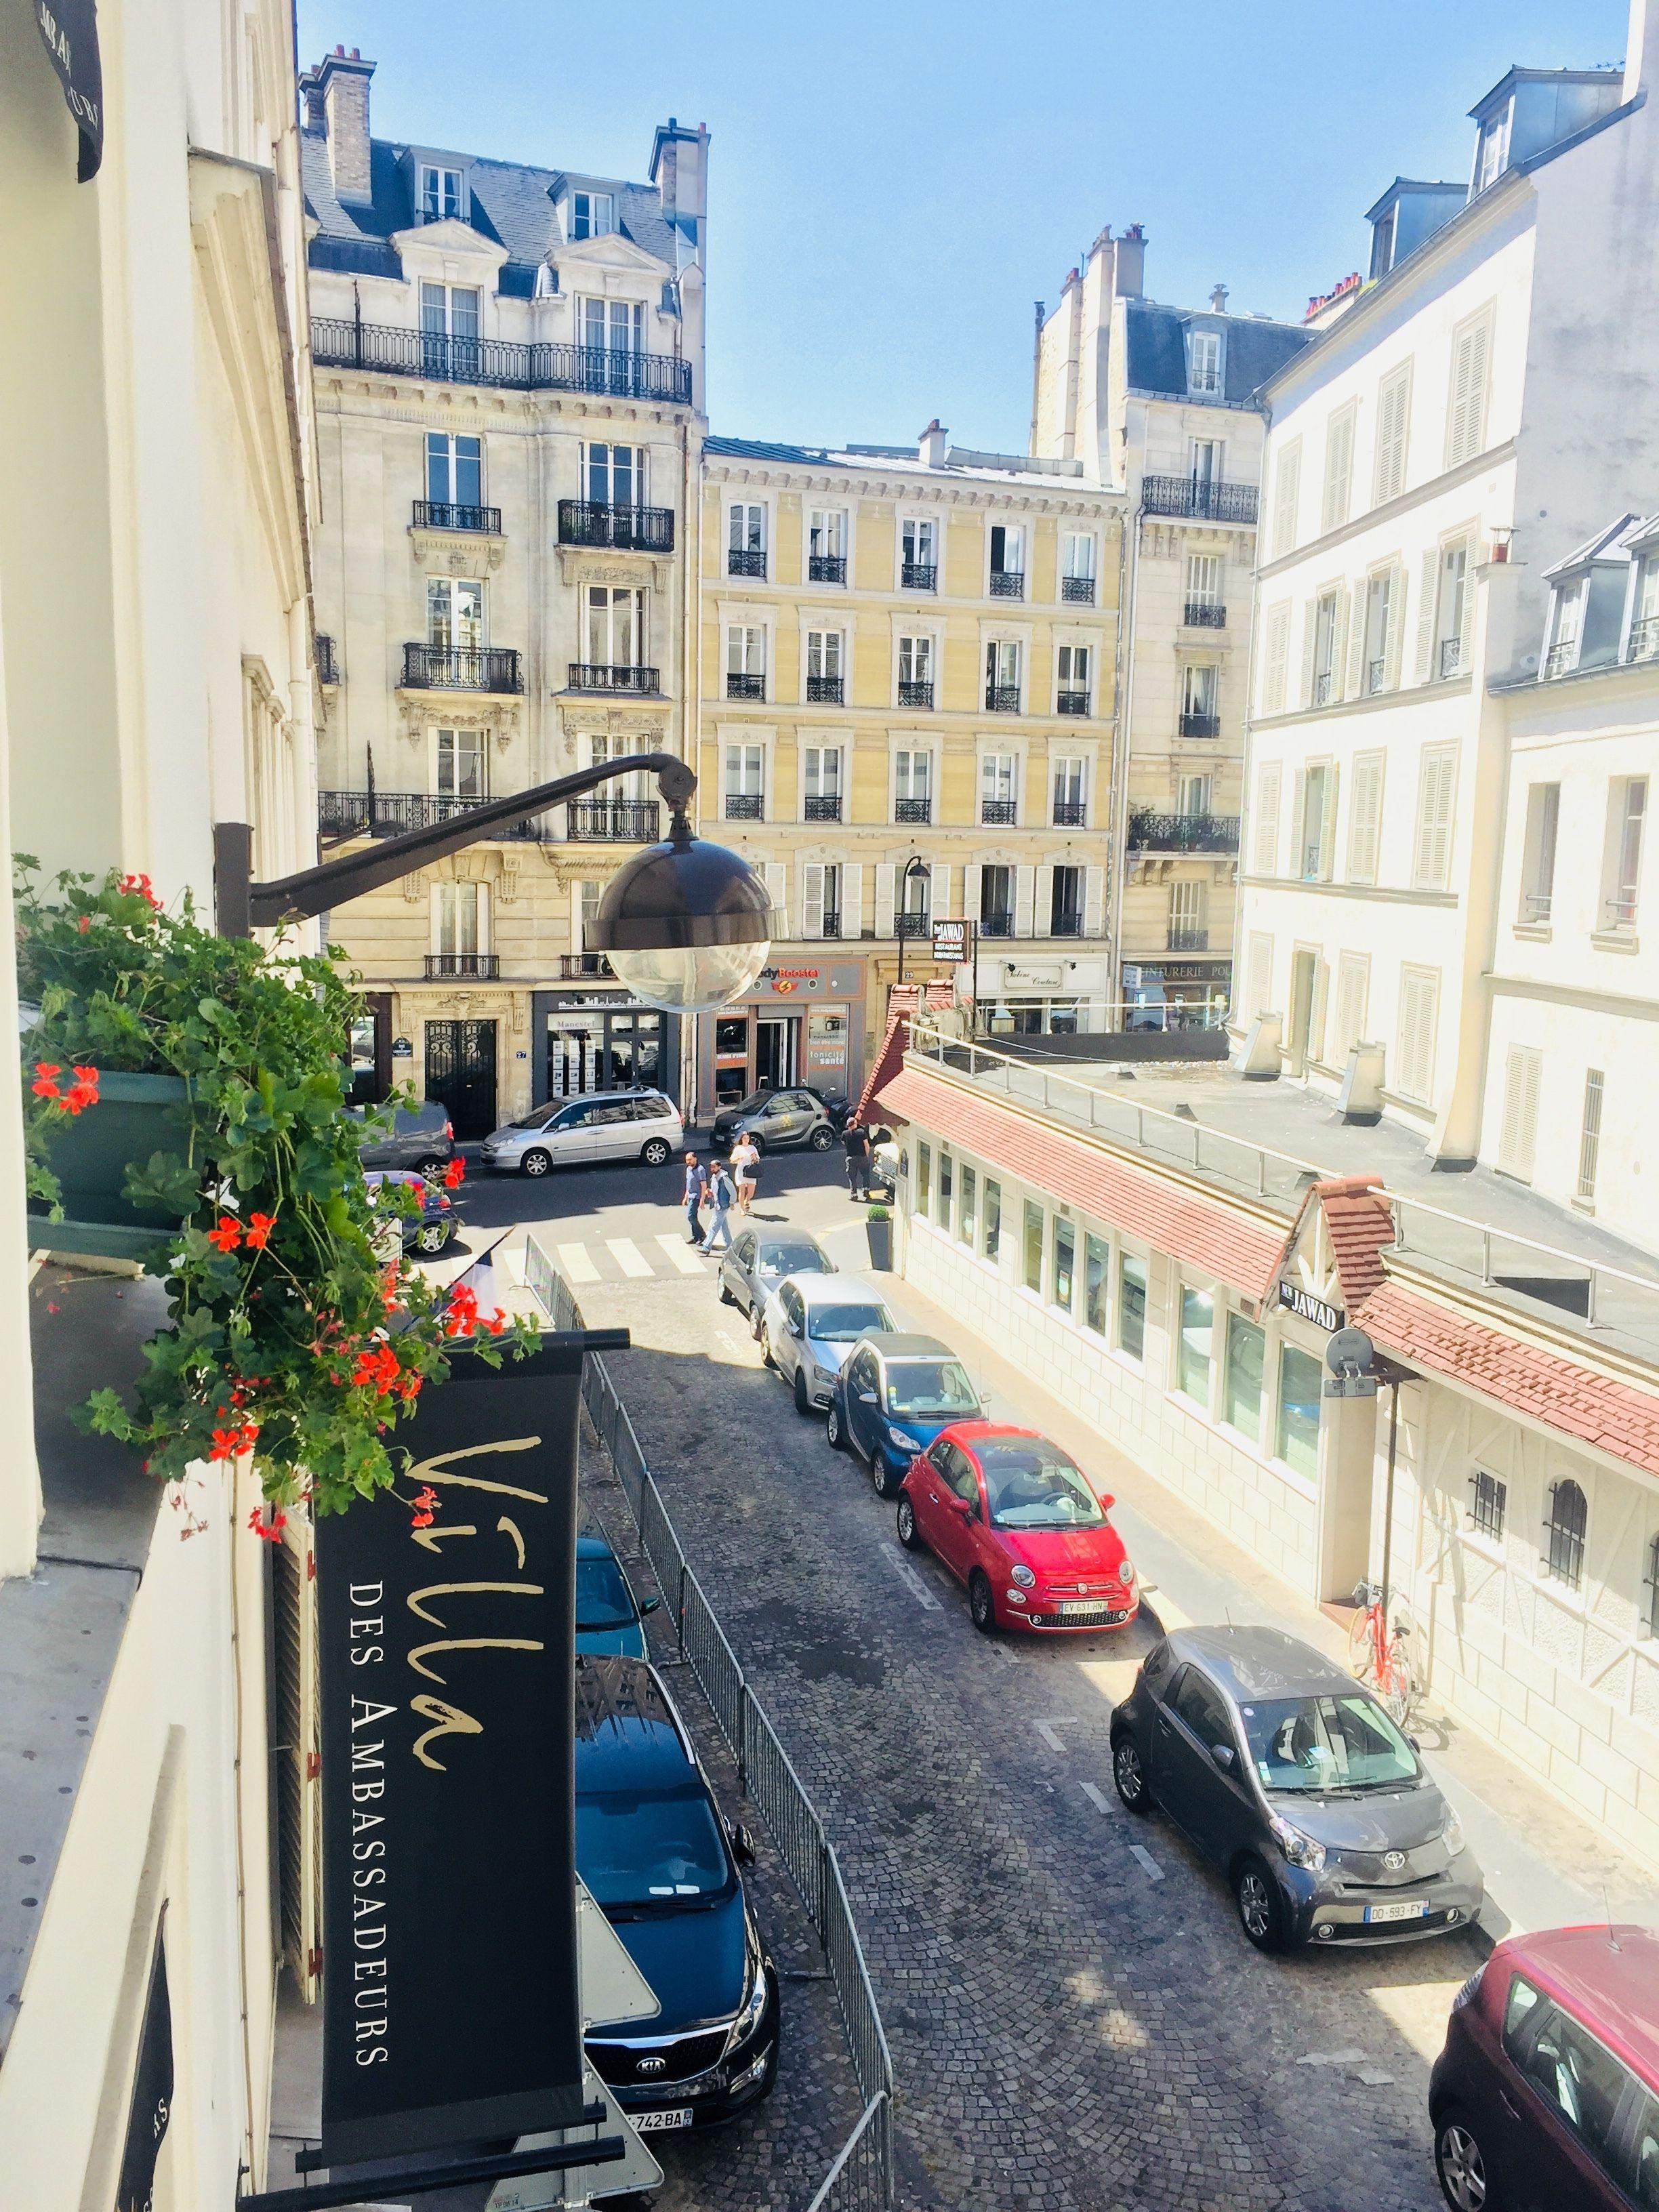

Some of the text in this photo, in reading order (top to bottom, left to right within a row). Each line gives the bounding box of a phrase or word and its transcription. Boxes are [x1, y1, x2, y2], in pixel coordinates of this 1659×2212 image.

[938, 924, 964, 941] JAWAD
[758, 967, 819, 980] odyBooster
[1141, 967, 1204, 977] EINTURERIE
[1292, 1290, 1336, 1331] JAWAD
[407, 1435, 549, 1772] Villa
[349, 1580, 398, 2068] DES AMBASSADEURS
[641, 2061, 661, 2071] KIA
[629, 2112, 682, 2129] -742-BA
